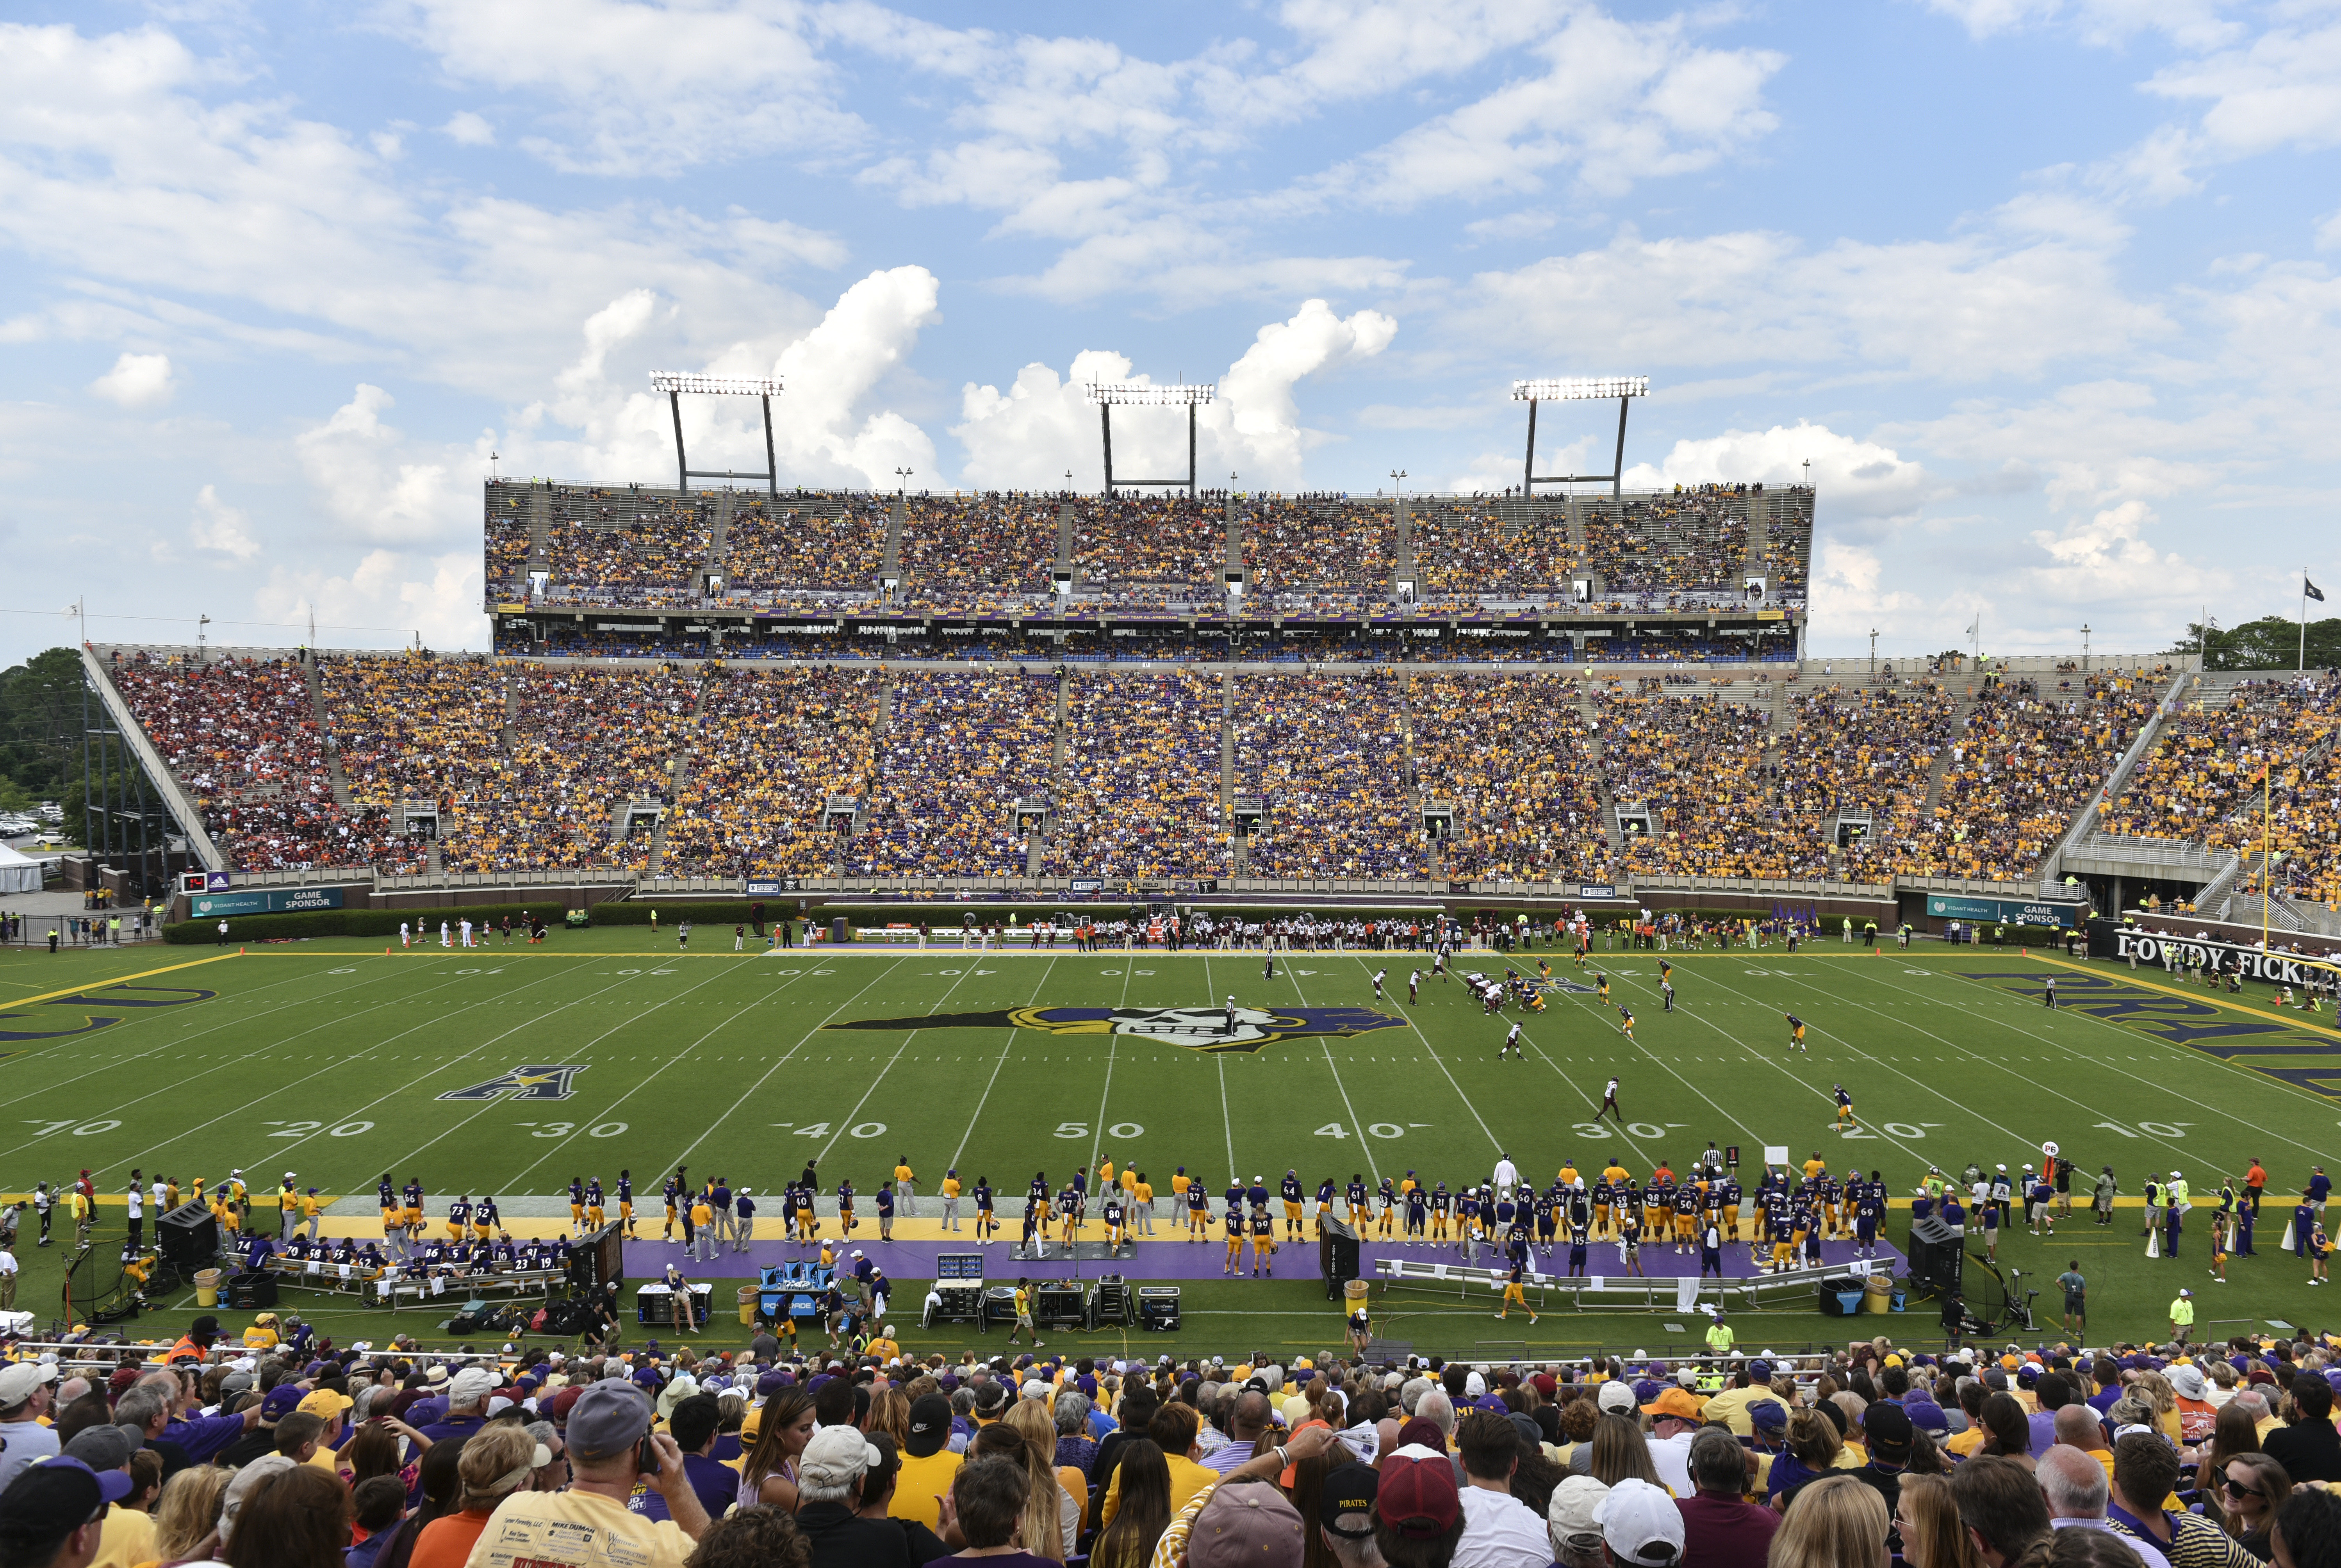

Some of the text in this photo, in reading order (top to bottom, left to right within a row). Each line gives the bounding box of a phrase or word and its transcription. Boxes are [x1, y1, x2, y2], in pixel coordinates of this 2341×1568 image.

[190, 878, 203, 888] 14
[285, 898, 330, 909] SPONSOR
[2024, 906, 2052, 915] GAME
[2015, 913, 2061, 924] SPONSOR
[32, 1120, 122, 1135] 10
[267, 1121, 374, 1137] 20
[531, 1122, 629, 1138] 30
[792, 1122, 887, 1138] 40
[1052, 1123, 1144, 1138] 50
[1314, 1123, 1404, 1139] 40
[1571, 1123, 1665, 1139] 30
[1828, 1123, 1926, 1139] 20
[2092, 1122, 2186, 1138] 10
[1730, 1149, 1736, 1160] 1
[1284, 1186, 1295, 1196] 64
[1351, 1191, 1359, 1199] 61
[405, 1194, 415, 1203] 66
[587, 1194, 597, 1202] 24
[1413, 1196, 1422, 1204] 43
[1556, 1194, 1564, 1203] 51
[1598, 1193, 1609, 1201] 92
[1647, 1194, 1659, 1202] 98
[1729, 1193, 1739, 1201] 56
[1832, 1192, 1840, 1201] 14
[1063, 1199, 1072, 1208] 47
[1437, 1198, 1444, 1206] 31
[1680, 1200, 1692, 1209] 50
[477, 1208, 489, 1217] 52
[1861, 1208, 1873, 1216] 69
[1256, 1216, 1268, 1226] 99
[1801, 1215, 1808, 1224] 9
[1514, 1231, 1524, 1241] 25
[1784, 1228, 1791, 1237] 2
[239, 1241, 251, 1251] 74
[287, 1247, 300, 1257] 70
[310, 1249, 321, 1258] 58
[425, 1249, 438, 1257] 86
[498, 1253, 507, 1261] 10
[541, 1254, 551, 1263] 19
[516, 1260, 527, 1269] 23
[1339, 1499, 1367, 1508] PIRATES
[568, 1524, 596, 1534] DUMAN
[554, 1533, 583, 1541] Superstore
[608, 1532, 639, 1548] WHITEHEAD
[607, 1543, 647, 1560] CONSTRUCTION
[552, 1556, 587, 1567] Annual
